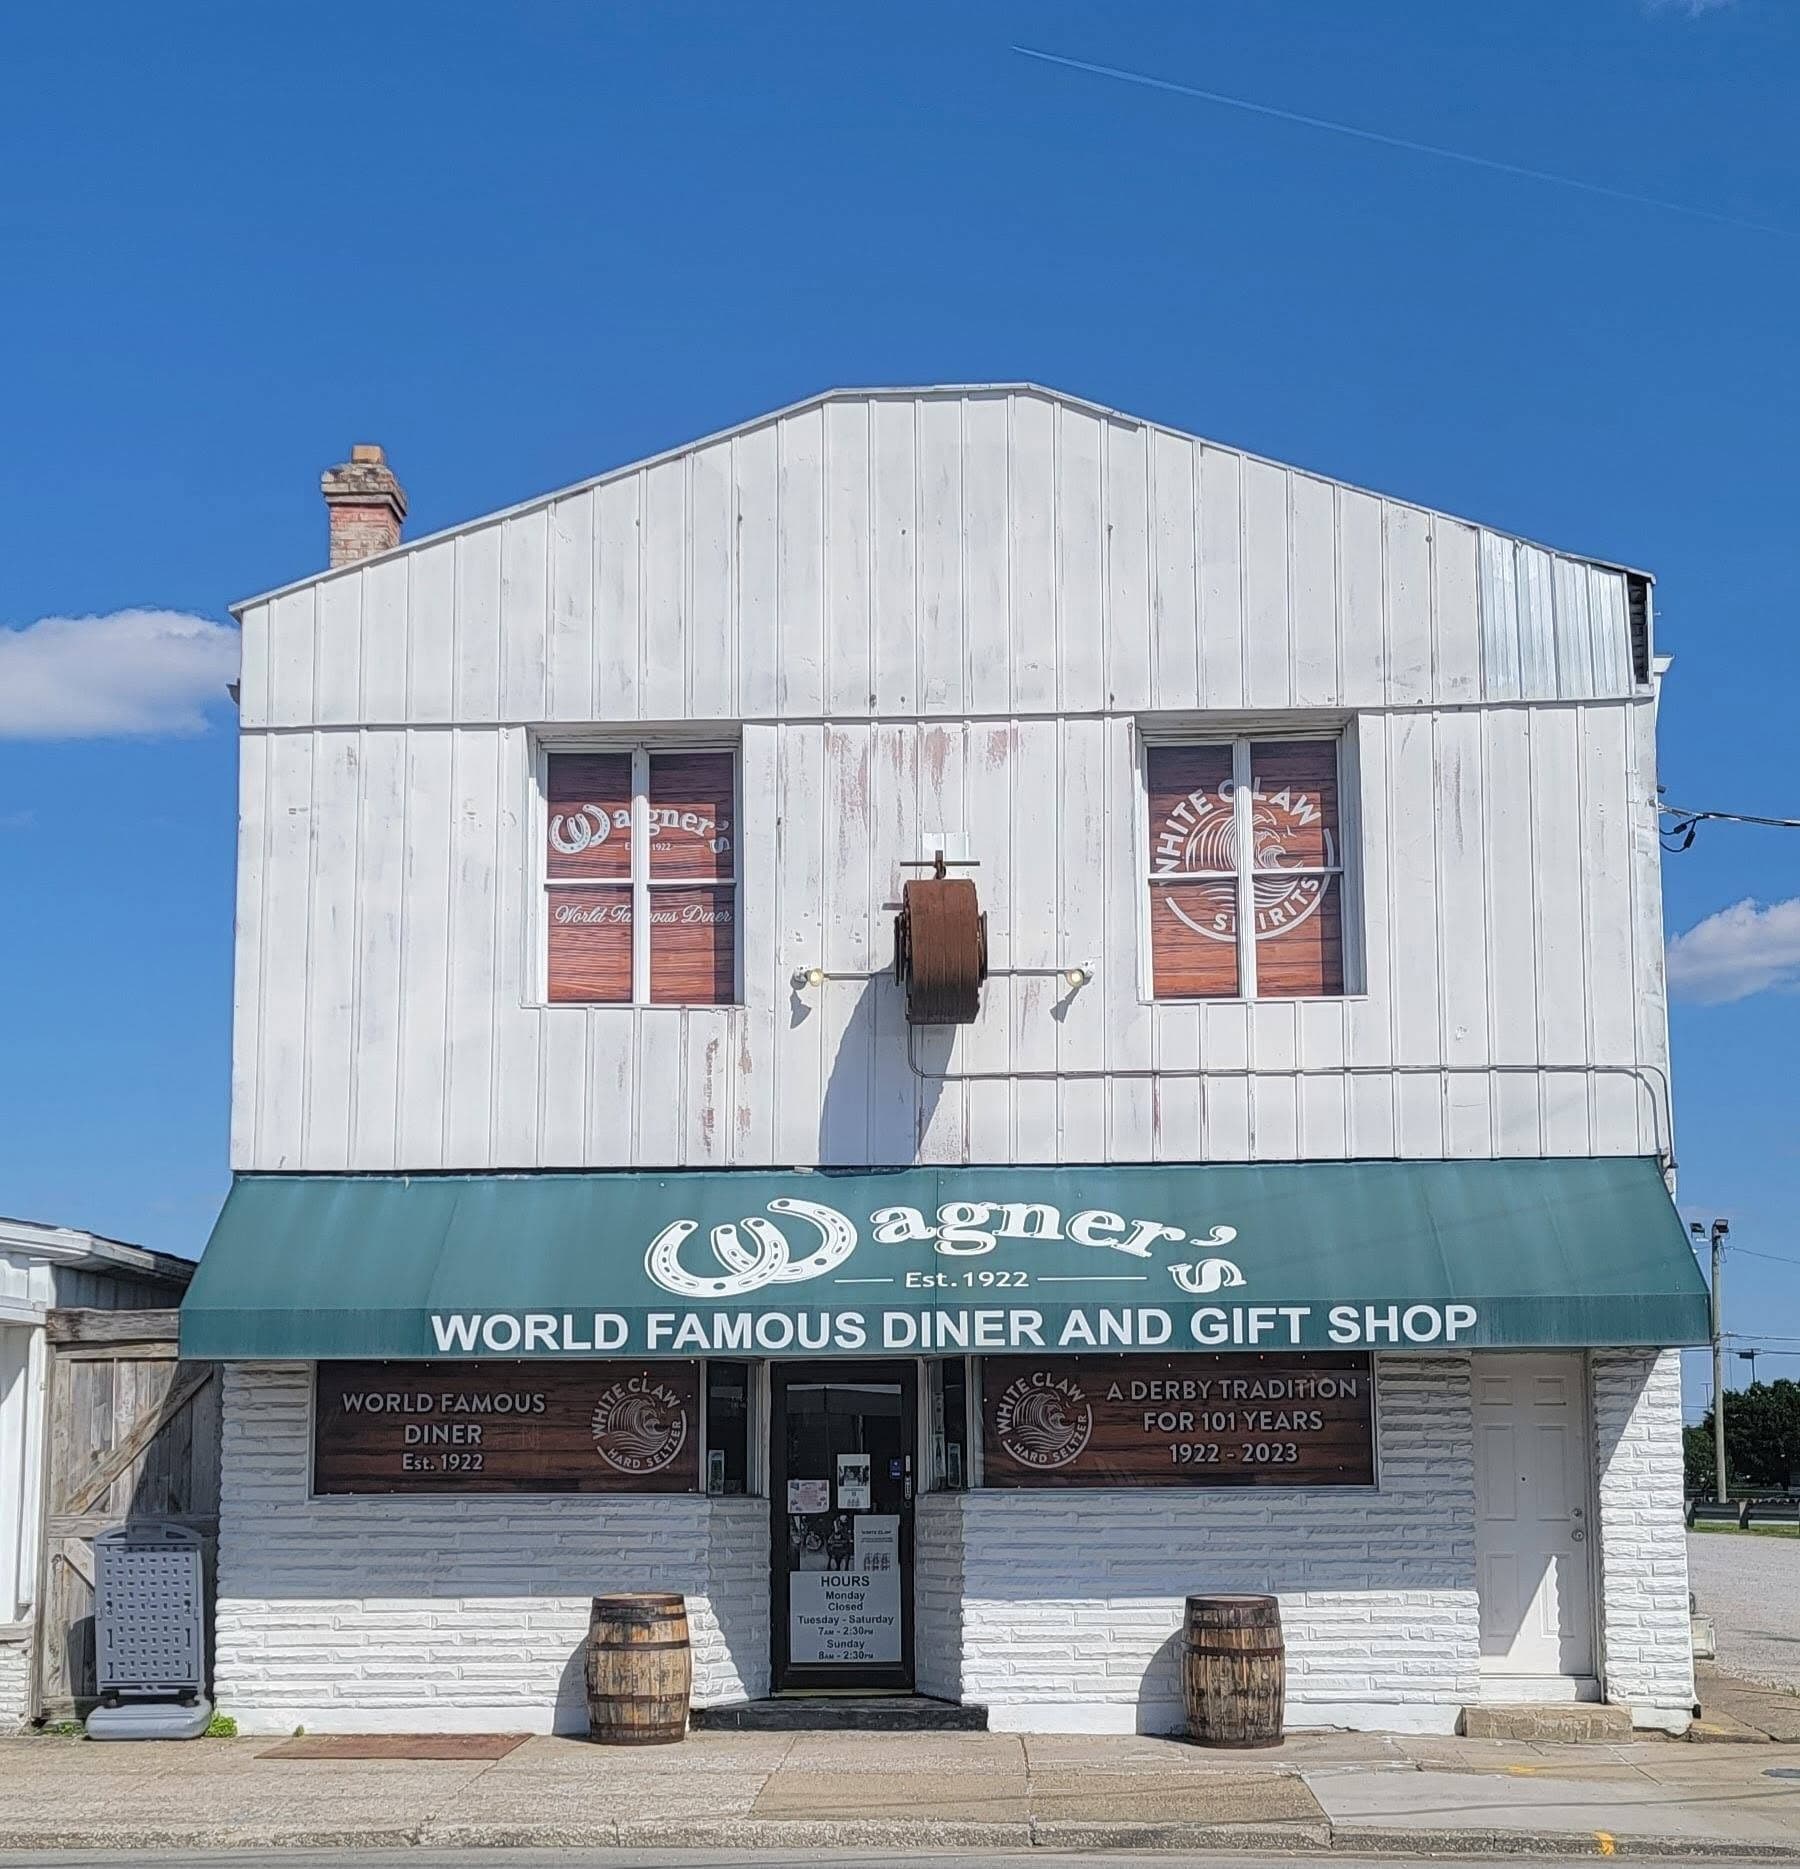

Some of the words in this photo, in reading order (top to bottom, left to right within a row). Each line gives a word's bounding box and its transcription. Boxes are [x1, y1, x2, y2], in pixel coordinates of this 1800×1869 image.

[555, 905, 605, 923] World
[609, 905, 678, 923] Faous
[681, 904, 732, 923] Diner
[1212, 876, 1319, 933] SIRITS
[644, 1198, 1247, 1298] Wagner's
[431, 1312, 629, 1353] WORLD
[646, 1311, 867, 1351] FAMOUS
[883, 1309, 1044, 1350] DINER
[1058, 1308, 1173, 1347] AND
[1190, 1306, 1311, 1345] GIFT
[1327, 1304, 1478, 1344] SHOP
[1106, 1383, 1124, 1401] A
[1130, 1380, 1213, 1401] DERBY
[1218, 1378, 1358, 1400] TRADITION
[342, 1392, 433, 1414] WORLD
[441, 1392, 546, 1414] FAMOUS
[591, 1383, 626, 1440] WHITE
[627, 1377, 681, 1408] CLAW
[996, 1378, 1030, 1435] WHITE
[1031, 1372, 1086, 1402] CLAW
[1143, 1411, 1196, 1433] FOR
[1201, 1411, 1236, 1432] 101
[1242, 1410, 1324, 1432] YEARS
[404, 1423, 482, 1445] DINER
[607, 1448, 641, 1468] HARD
[646, 1421, 682, 1467] SELTZER
[1013, 1443, 1048, 1463] HARD
[1052, 1414, 1087, 1462] SELTZER
[402, 1453, 435, 1472] Est.
[441, 1453, 483, 1472] 1922
[1168, 1443, 1220, 1464] 1922
[1241, 1442, 1299, 1463] 2023
[820, 1575, 870, 1587] HOURS
[825, 1591, 866, 1601] Monday
[827, 1602, 864, 1611] Closed
[798, 1615, 840, 1626] Tuesday
[848, 1614, 894, 1625] Saturday
[826, 1639, 865, 1649] Sunday
